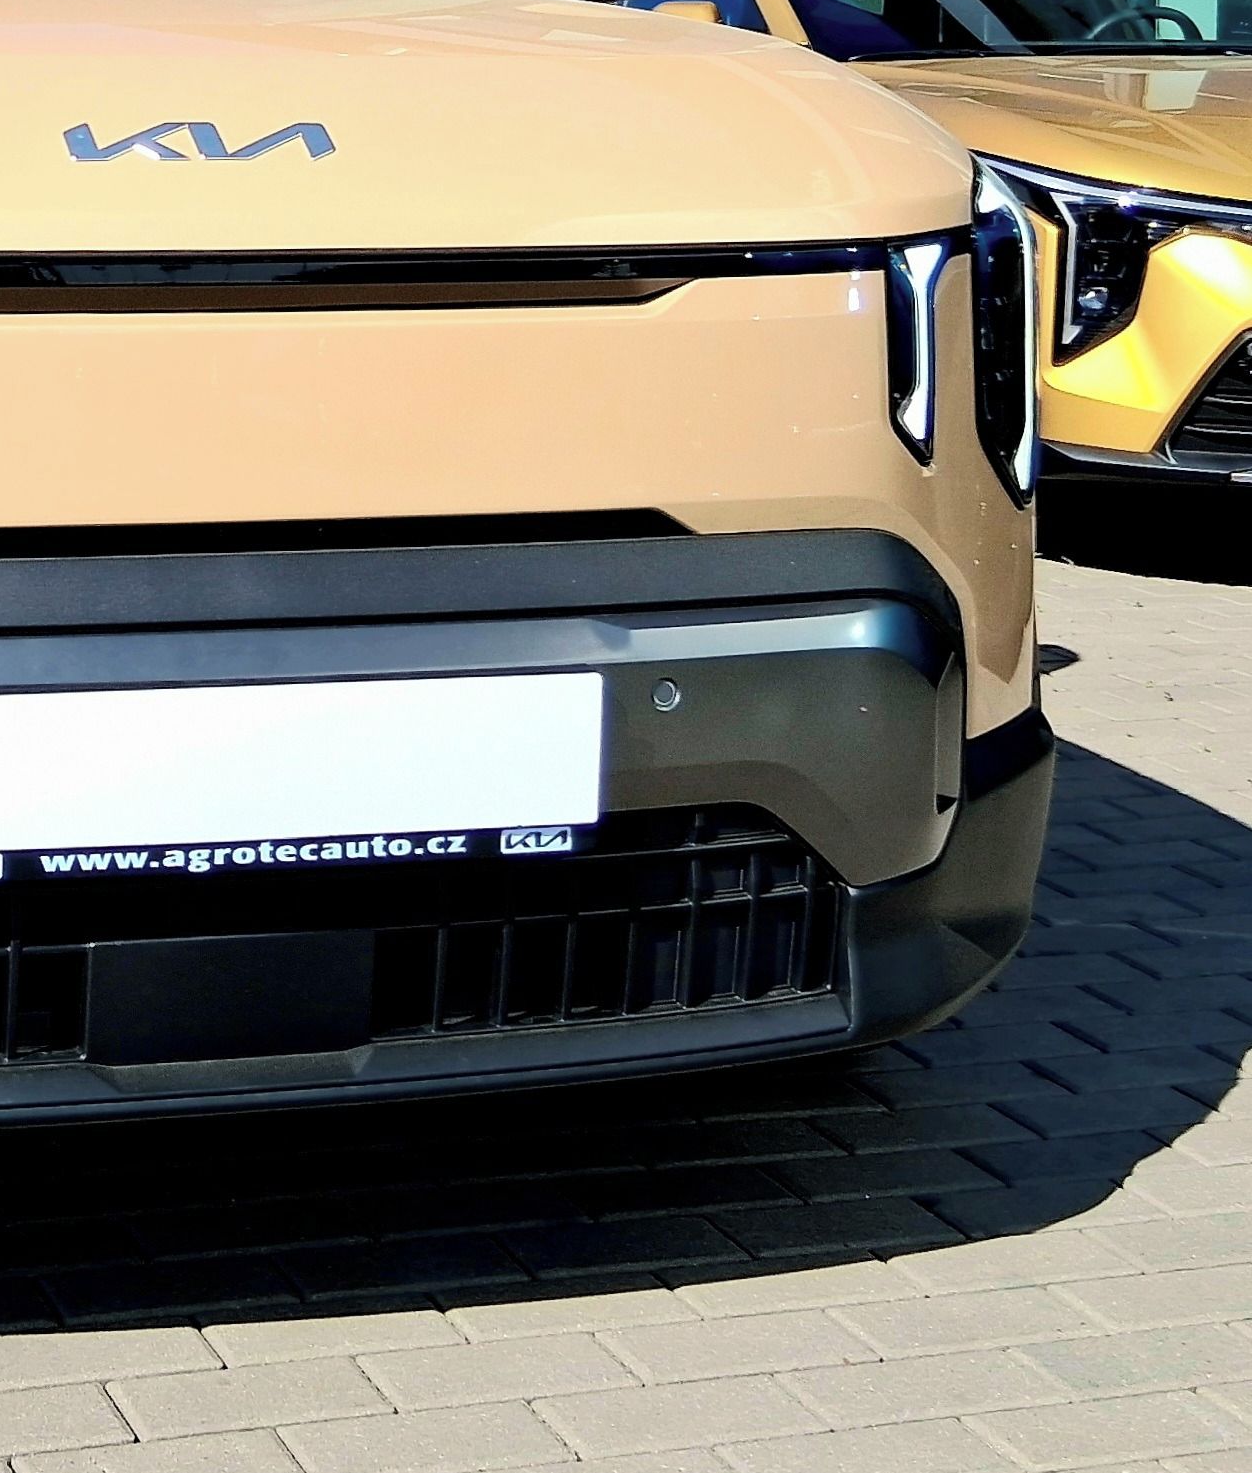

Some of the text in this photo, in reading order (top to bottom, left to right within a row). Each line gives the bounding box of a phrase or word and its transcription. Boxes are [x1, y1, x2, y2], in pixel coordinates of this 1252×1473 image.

[63, 121, 337, 162] KIA
[39, 834, 468, 874] www.agrotecauto.cz
[503, 828, 570, 850] KIA
